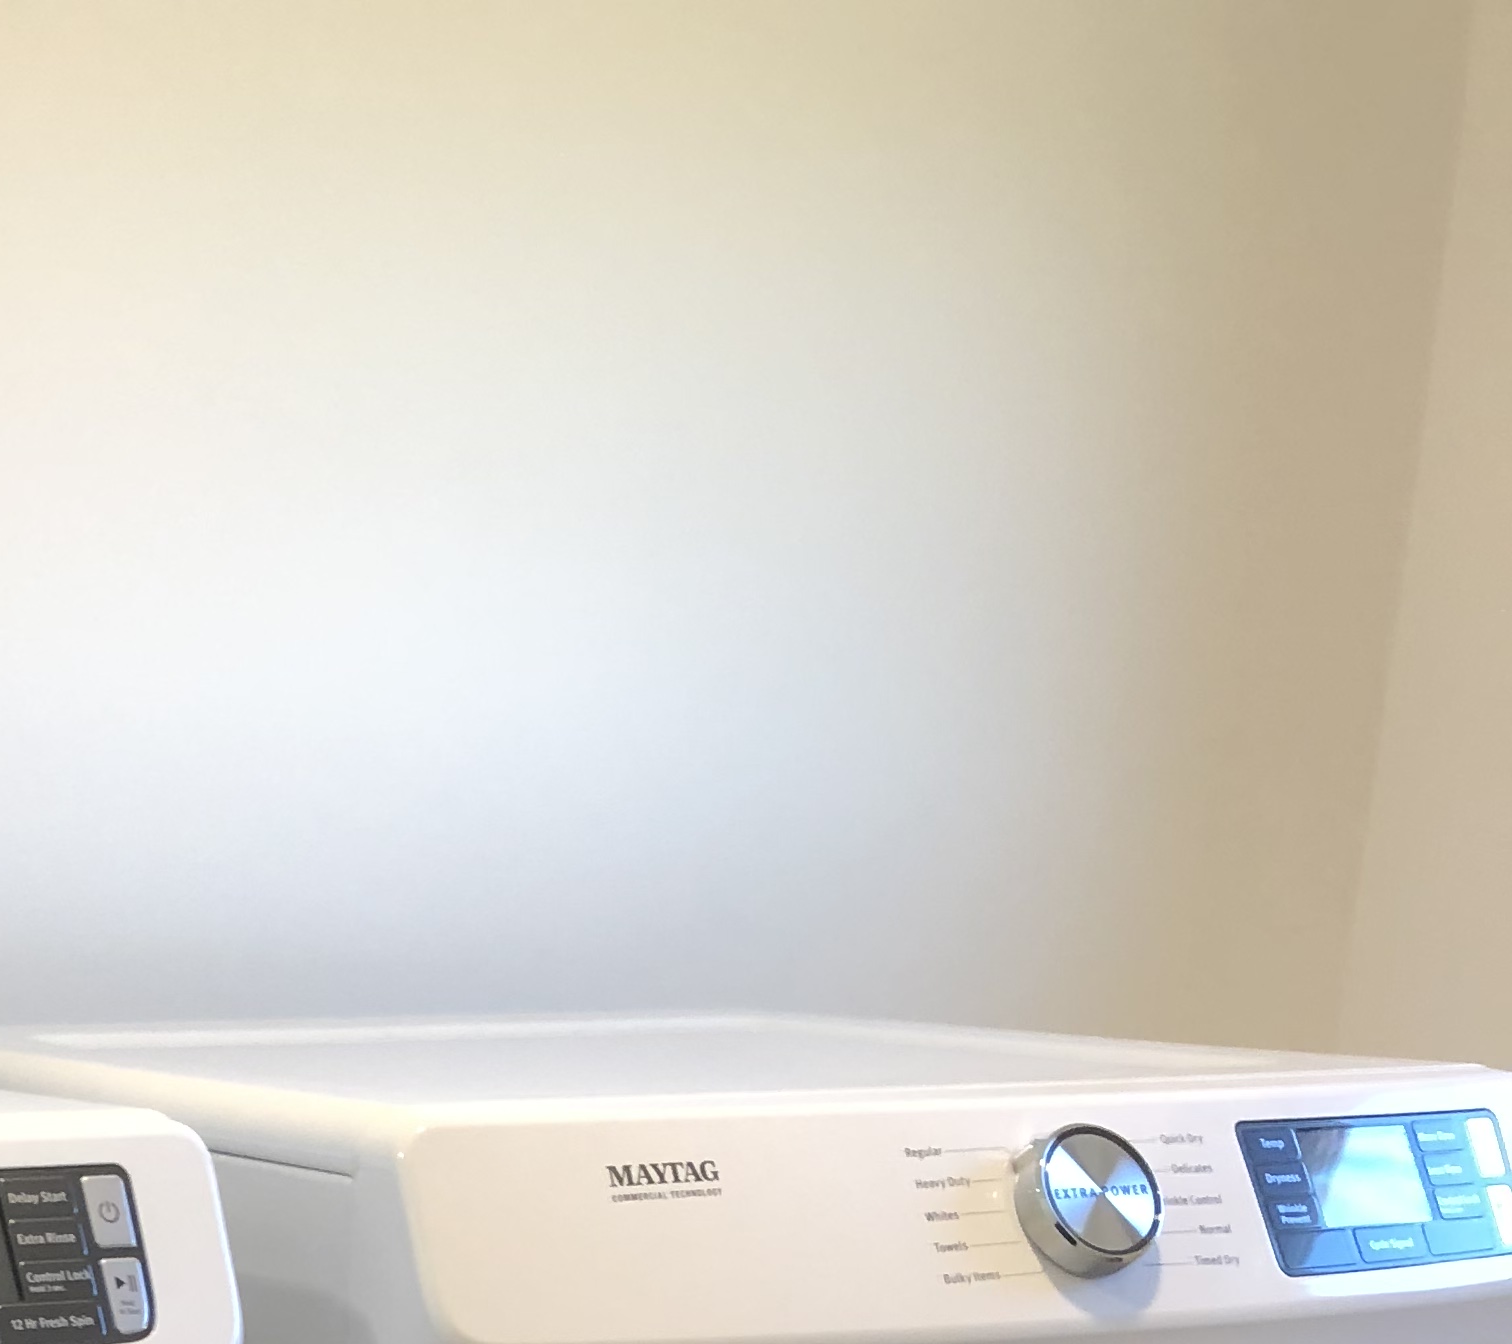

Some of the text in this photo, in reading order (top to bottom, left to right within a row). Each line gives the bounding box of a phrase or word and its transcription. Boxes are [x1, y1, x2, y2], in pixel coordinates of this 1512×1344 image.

[605, 1160, 720, 1187] MAYTAG
[40, 1191, 68, 1203] Start
[611, 1188, 722, 1202] COMMERCIAL TECHNOLOGY
[1054, 1184, 1148, 1200] EXTRA POWER
[11, 1315, 95, 1331] 12 Hr Fresh Spin
